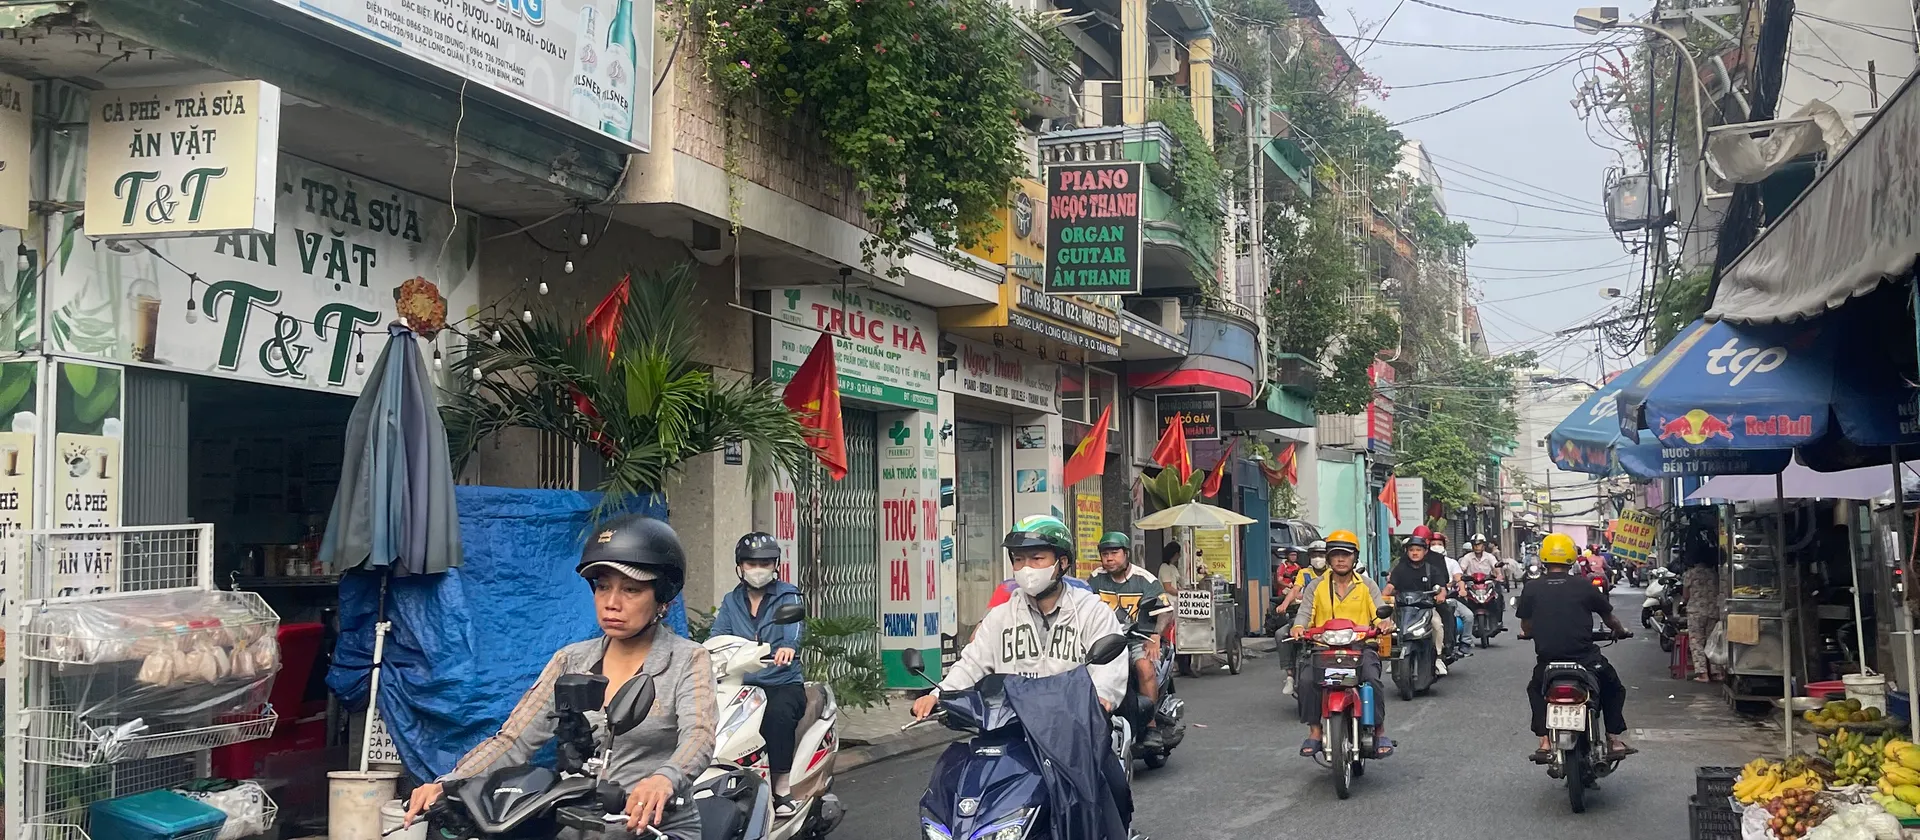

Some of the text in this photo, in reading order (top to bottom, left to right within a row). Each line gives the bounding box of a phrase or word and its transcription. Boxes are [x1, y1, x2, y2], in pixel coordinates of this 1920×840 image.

[366, 1, 382, 15] ĐIỆN
[422, 25, 433, 36] 330
[434, 31, 443, 41] 128
[367, 15, 379, 27] ĐỊA
[415, 35, 427, 47] LẠC
[428, 42, 445, 54] LONG
[434, 9, 454, 28] KHÔ
[472, 26, 499, 49] KHOAI
[516, 27, 533, 45] TRÁI
[558, 48, 568, 61] LY
[103, 97, 124, 122] CÀ
[129, 94, 160, 120] PHÊ
[174, 93, 207, 118] TRÀ
[601, 89, 629, 113] PILSNER
[129, 124, 217, 161] ĂN VẶT
[114, 167, 228, 226] T&T
[1059, 169, 1128, 191] PIANO
[301, 182, 362, 227] TRÀ
[1050, 195, 1087, 223] NGỌC
[1089, 193, 1137, 218] THANH
[1061, 225, 1124, 243] ORGAN
[295, 227, 376, 292] VẶT
[1057, 247, 1126, 265] GUITAR
[1052, 266, 1076, 287] ÂM
[1079, 269, 1131, 287] THANH
[832, 288, 862, 307] NHÀ
[1022, 287, 1033, 305] ĐT:
[1034, 291, 1050, 312] 0903
[1052, 298, 1064, 316] 381
[1097, 314, 1107, 331] 550
[202, 280, 381, 386] T&T
[811, 302, 926, 355] TRÚC HÀ
[1032, 322, 1044, 333] LẠC
[1045, 325, 1061, 339] LONG
[1107, 344, 1119, 357] BÌNH
[836, 339, 854, 351] ĐẠT
[856, 344, 884, 357] CHUẨN
[963, 344, 1023, 382] Ngọc Thanh
[1706, 337, 1788, 387] tcp
[964, 378, 976, 391] PIANO
[1744, 415, 1812, 436] Red Bull
[883, 464, 917, 480] NHÀ THUỐC
[65, 488, 108, 512] CÀ PHÊ
[774, 479, 795, 540] TRÚC
[883, 489, 917, 542] TRÚC
[922, 489, 937, 541] TRÚC
[1623, 524, 1639, 535] CAM
[58, 547, 112, 579] ĂN VẶT
[891, 547, 910, 601] HÀ
[926, 547, 936, 600] HÀ
[884, 613, 918, 637] PHARMACY
[1179, 608, 1192, 616] XÔI
